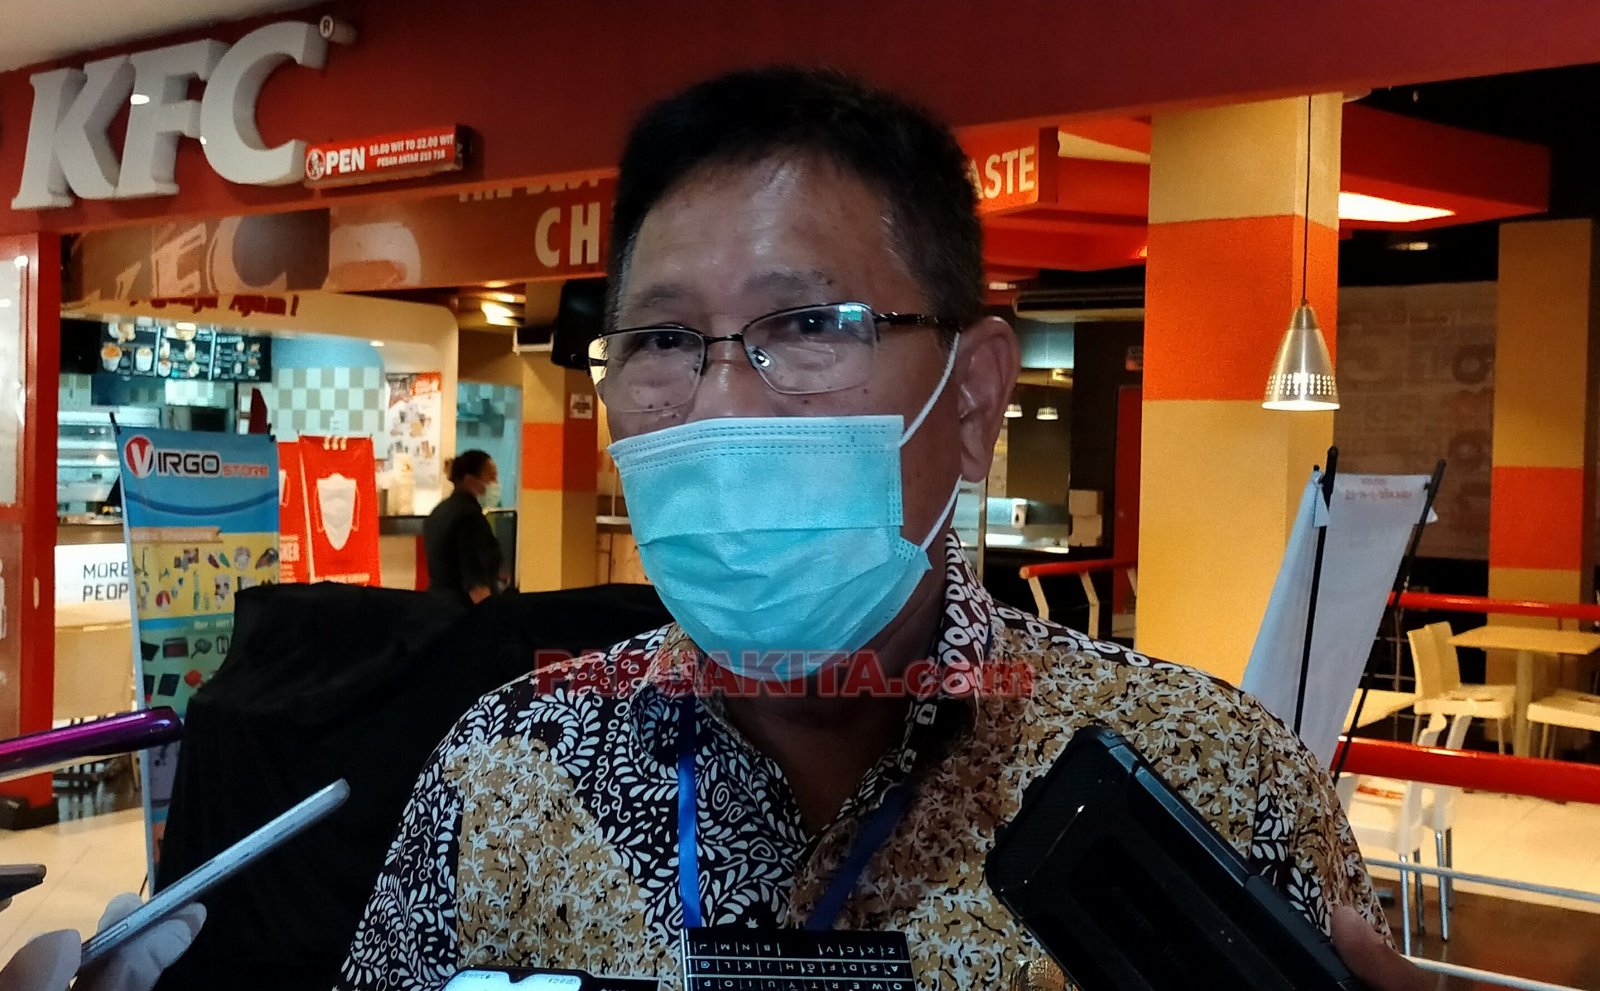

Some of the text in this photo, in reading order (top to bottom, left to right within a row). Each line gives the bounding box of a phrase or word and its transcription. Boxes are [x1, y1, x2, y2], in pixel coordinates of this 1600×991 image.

[11, 20, 320, 211] KFC
[406, 139, 416, 151] TO
[125, 434, 269, 477] VIRGO STORE
[83, 561, 129, 579] MORE
[82, 582, 129, 602] PEOP
